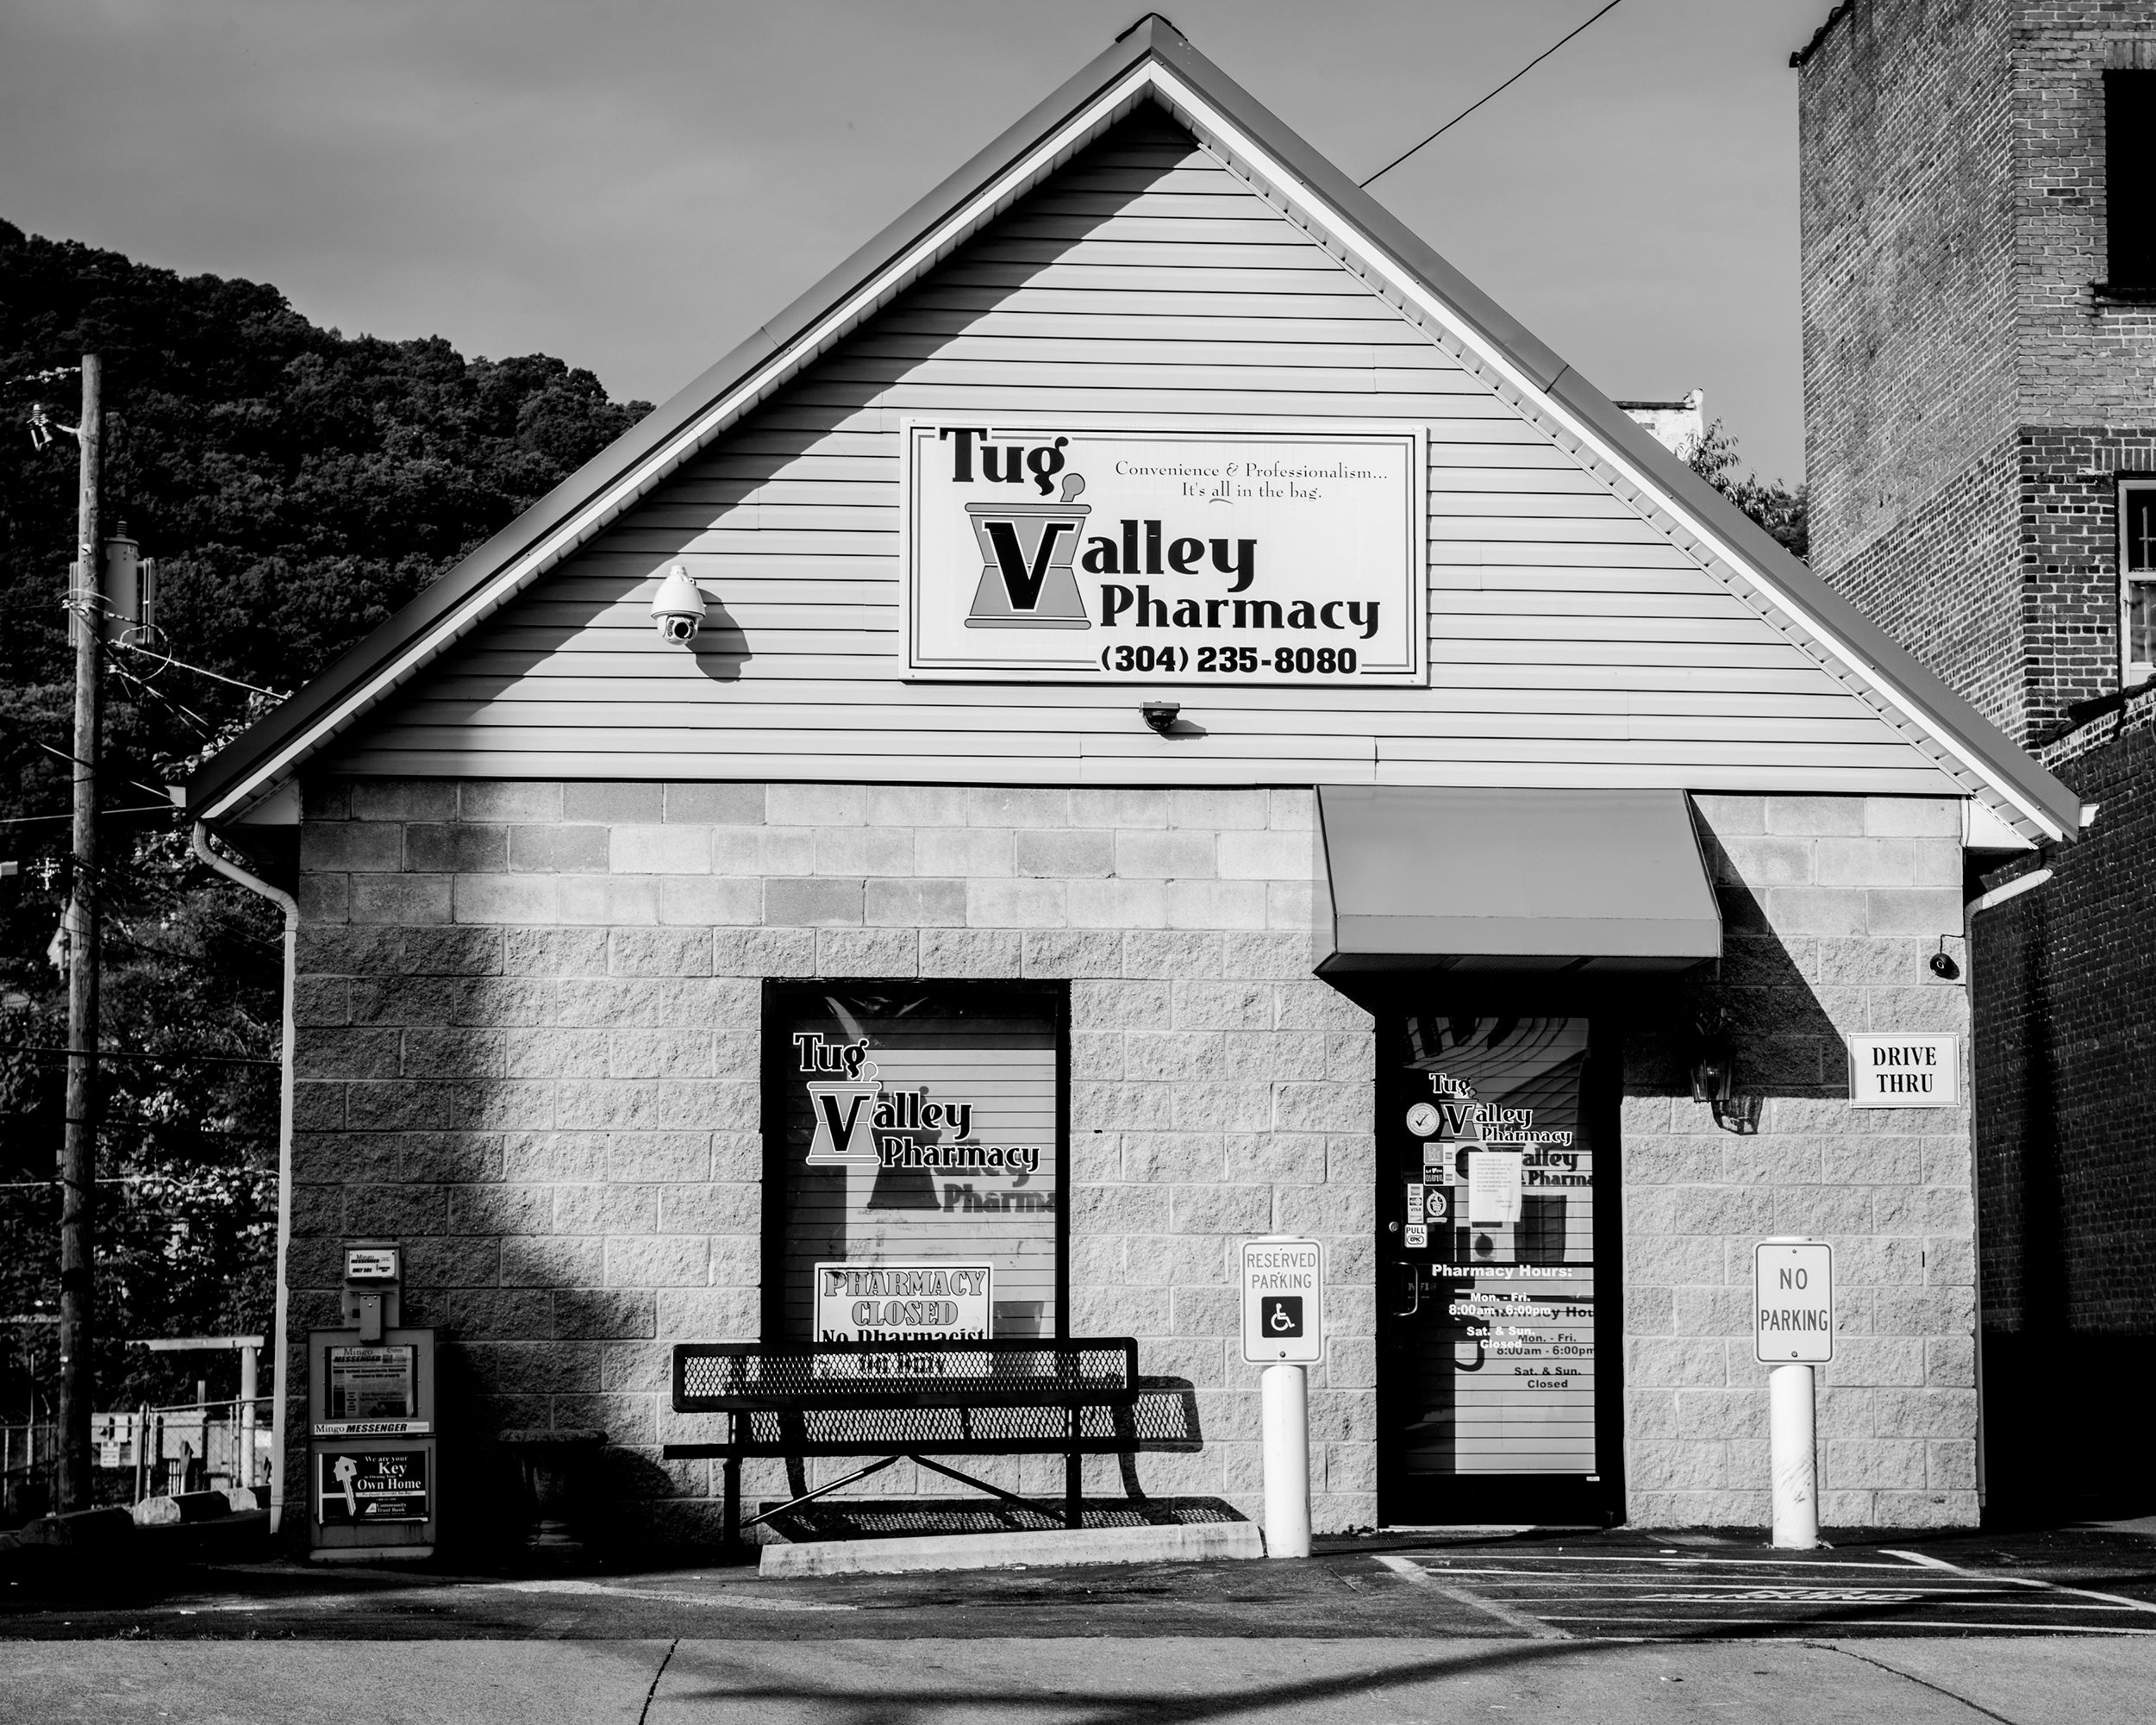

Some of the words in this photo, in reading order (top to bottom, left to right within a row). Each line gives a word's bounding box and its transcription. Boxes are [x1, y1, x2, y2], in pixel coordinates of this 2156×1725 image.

[939, 428, 1069, 496] Tug
[1115, 460, 1219, 476] Convenience
[1226, 463, 1239, 476] &
[1246, 461, 1387, 479] Professionalism...
[1182, 482, 1205, 497] It's
[1211, 481, 1231, 497] all
[1237, 484, 1252, 497] in
[1259, 482, 1284, 497] the
[1290, 482, 1322, 501] bag.
[983, 519, 1258, 610] Valley
[1100, 584, 1381, 640] Pharmacy
[1101, 646, 1189, 673] (304)
[1197, 647, 1358, 674] 235-8080
[793, 1032, 869, 1081] Tug
[1872, 1047, 1937, 1066] DRIVE
[1429, 1073, 1472, 1096] Tug
[1876, 1073, 1933, 1093] THRU
[819, 1091, 973, 1153] Valley
[1445, 1103, 1533, 1135] Valley
[1481, 1127, 1572, 1145] Pharmacy
[882, 1136, 1041, 1172] Pharmacy
[1247, 1253, 1316, 1268] RESERVED
[1252, 1273, 1312, 1289] PARKING
[1432, 1265, 1514, 1279] Pharmacy
[1519, 1265, 1572, 1278] Hours:
[1779, 1268, 1808, 1290] NO
[824, 1270, 986, 1297] PHARMACY
[1471, 1293, 1500, 1303] Mon.
[1511, 1292, 1531, 1303] Fri.
[852, 1300, 959, 1326] CLOSED
[1448, 1304, 1496, 1316] 8:00am
[1505, 1304, 1552, 1317] 6:00pm
[1760, 1309, 1828, 1331] PARKING
[1466, 1326, 1491, 1336] Sat.
[1495, 1327, 1504, 1336] &
[1509, 1326, 1535, 1337] Sun.
[1558, 1334, 1577, 1342] Fri.
[1480, 1339, 1522, 1349] Closed
[1514, 1367, 1538, 1376] Sat.
[1542, 1367, 1553, 1376] &
[1555, 1367, 1582, 1376] Sun.
[1528, 1379, 1568, 1389] Closed
[316, 1424, 345, 1434] Mingo
[347, 1423, 408, 1434] MESSENGER
[379, 1462, 408, 1477] Key
[357, 1478, 384, 1491] Own
[388, 1478, 422, 1490] Home
